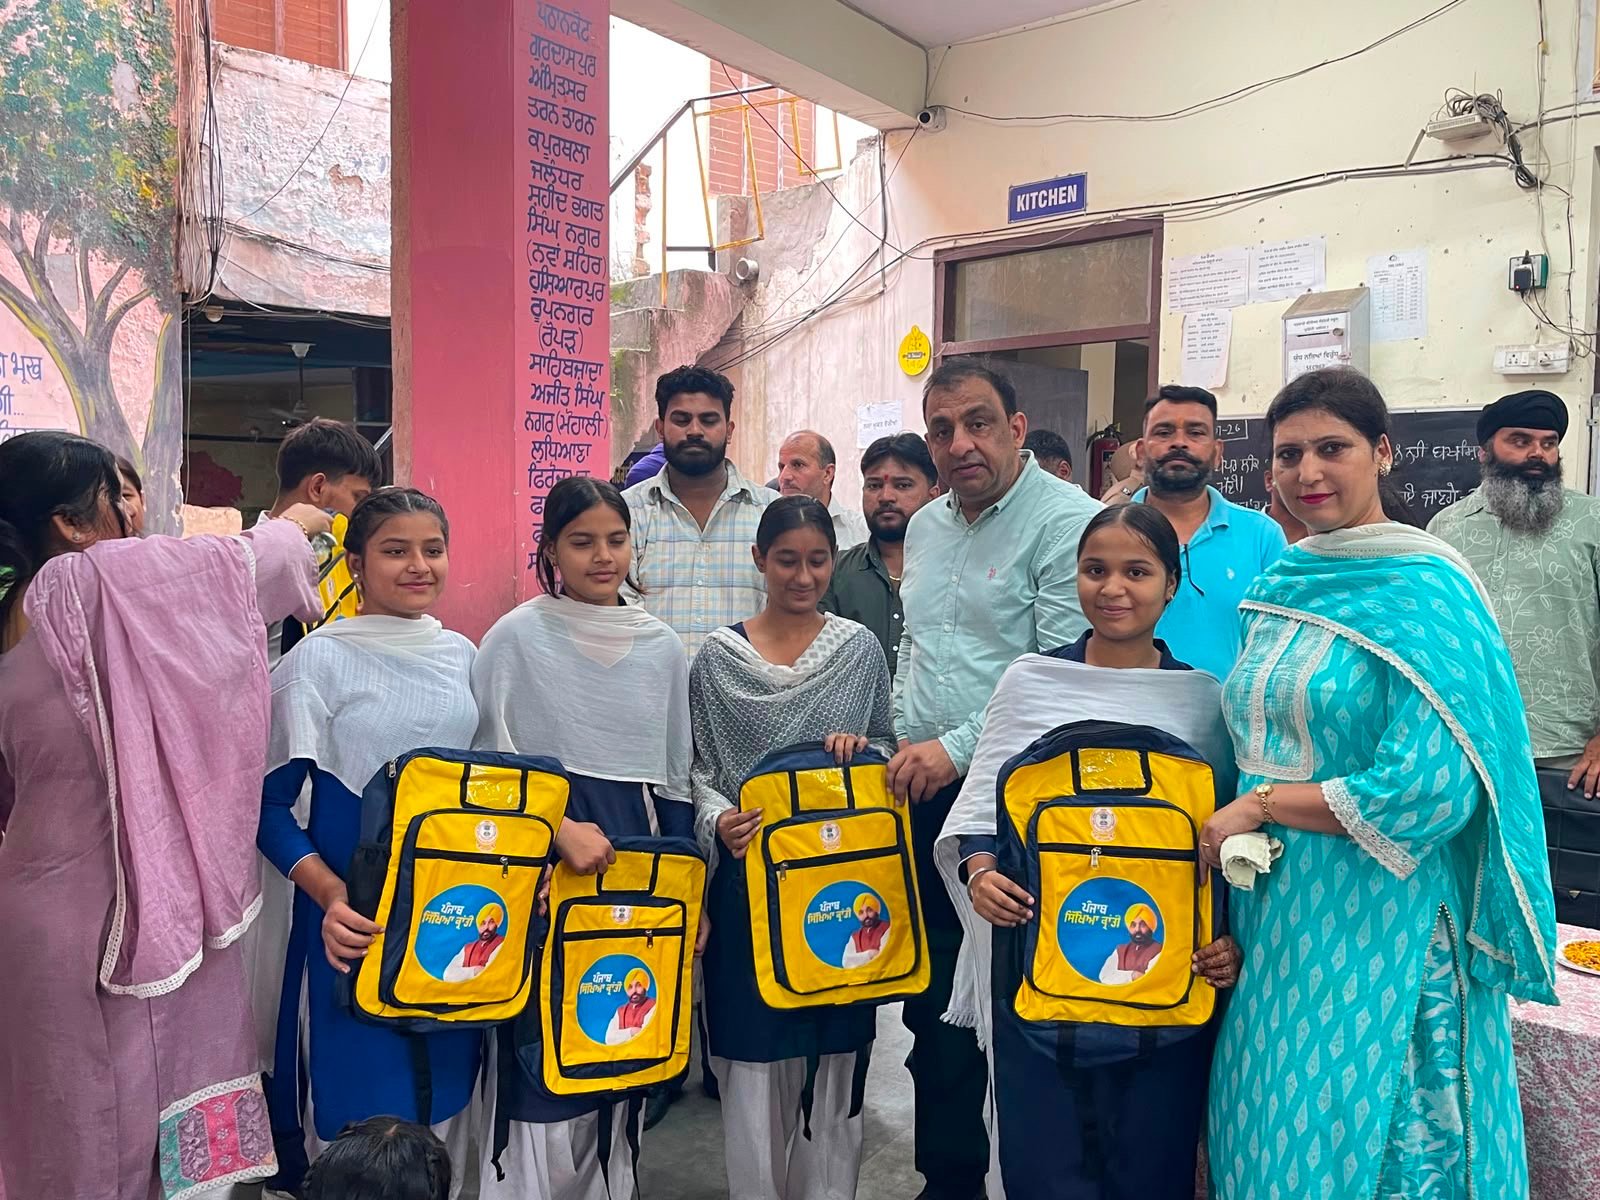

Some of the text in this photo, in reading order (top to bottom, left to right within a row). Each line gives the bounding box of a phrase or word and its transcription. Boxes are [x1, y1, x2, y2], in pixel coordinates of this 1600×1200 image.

[530, 33, 597, 78] ਗੁਰਦਾਸਪੁਰ
[528, 96, 597, 136] ਤਰਨ ਤਾਰਨ
[528, 128, 591, 165] ਕਪੂਰਥਲਾ
[530, 159, 584, 191] ਜਲੰਧਰ
[528, 183, 605, 222] ਸ਼ਹੀਦ ਭਗਤ
[1016, 184, 1078, 213] KITCHEN
[527, 206, 601, 249] ਸਿੰਘ ਨਗਰ
[530, 296, 595, 326] ਰੂਪਨਗਰ
[538, 320, 584, 356] (ਰੋਪੜ)
[530, 379, 605, 410] ਅਜੀਤ ਸਿੰਘ
[524, 411, 555, 433] ਨਗਰ
[531, 434, 592, 463] ਲੁਧਿਆਣਾ
